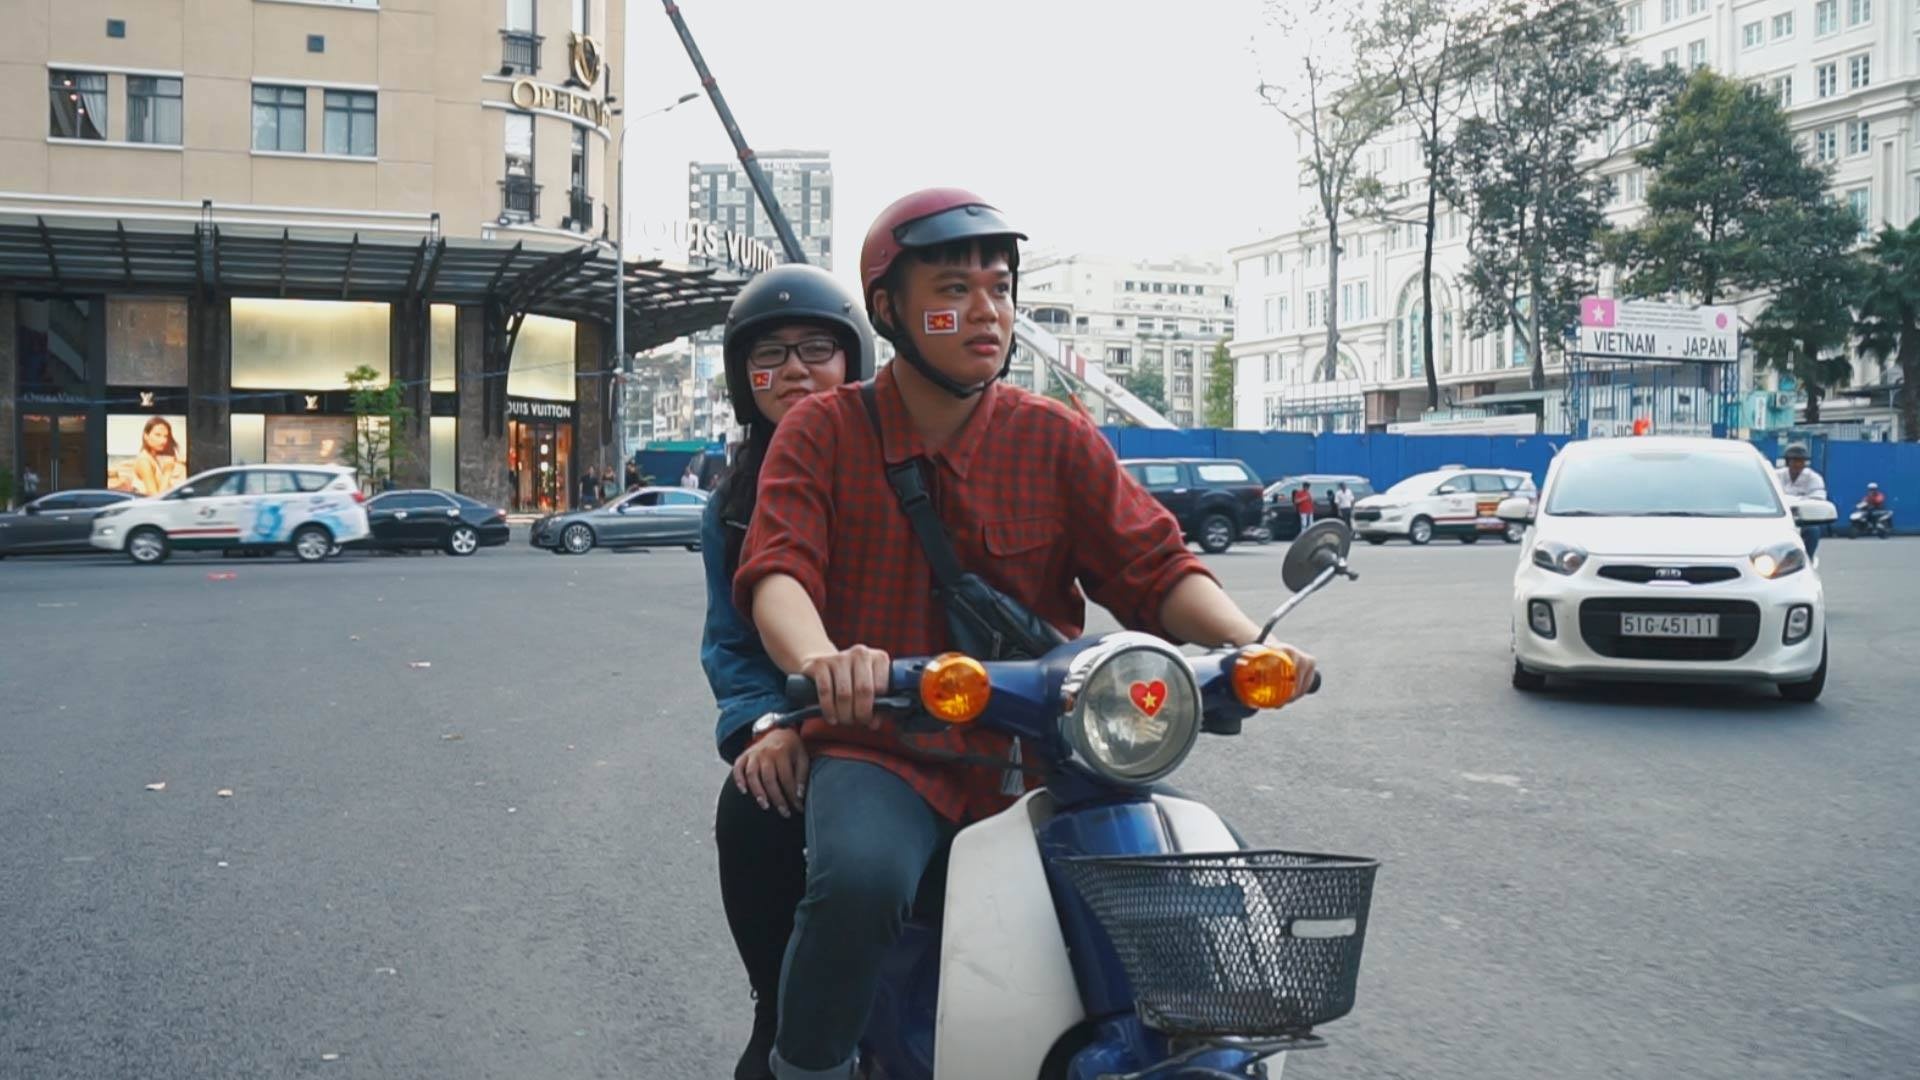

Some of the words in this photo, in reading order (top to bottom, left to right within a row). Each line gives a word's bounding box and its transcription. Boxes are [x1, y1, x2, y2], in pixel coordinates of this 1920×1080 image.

[726, 229, 776, 272] VUITTO
[1594, 331, 1656, 354] VIETNAM
[1683, 335, 1727, 358] JAPAN
[506, 401, 529, 416] OUIS
[530, 402, 571, 418] VUITTON
